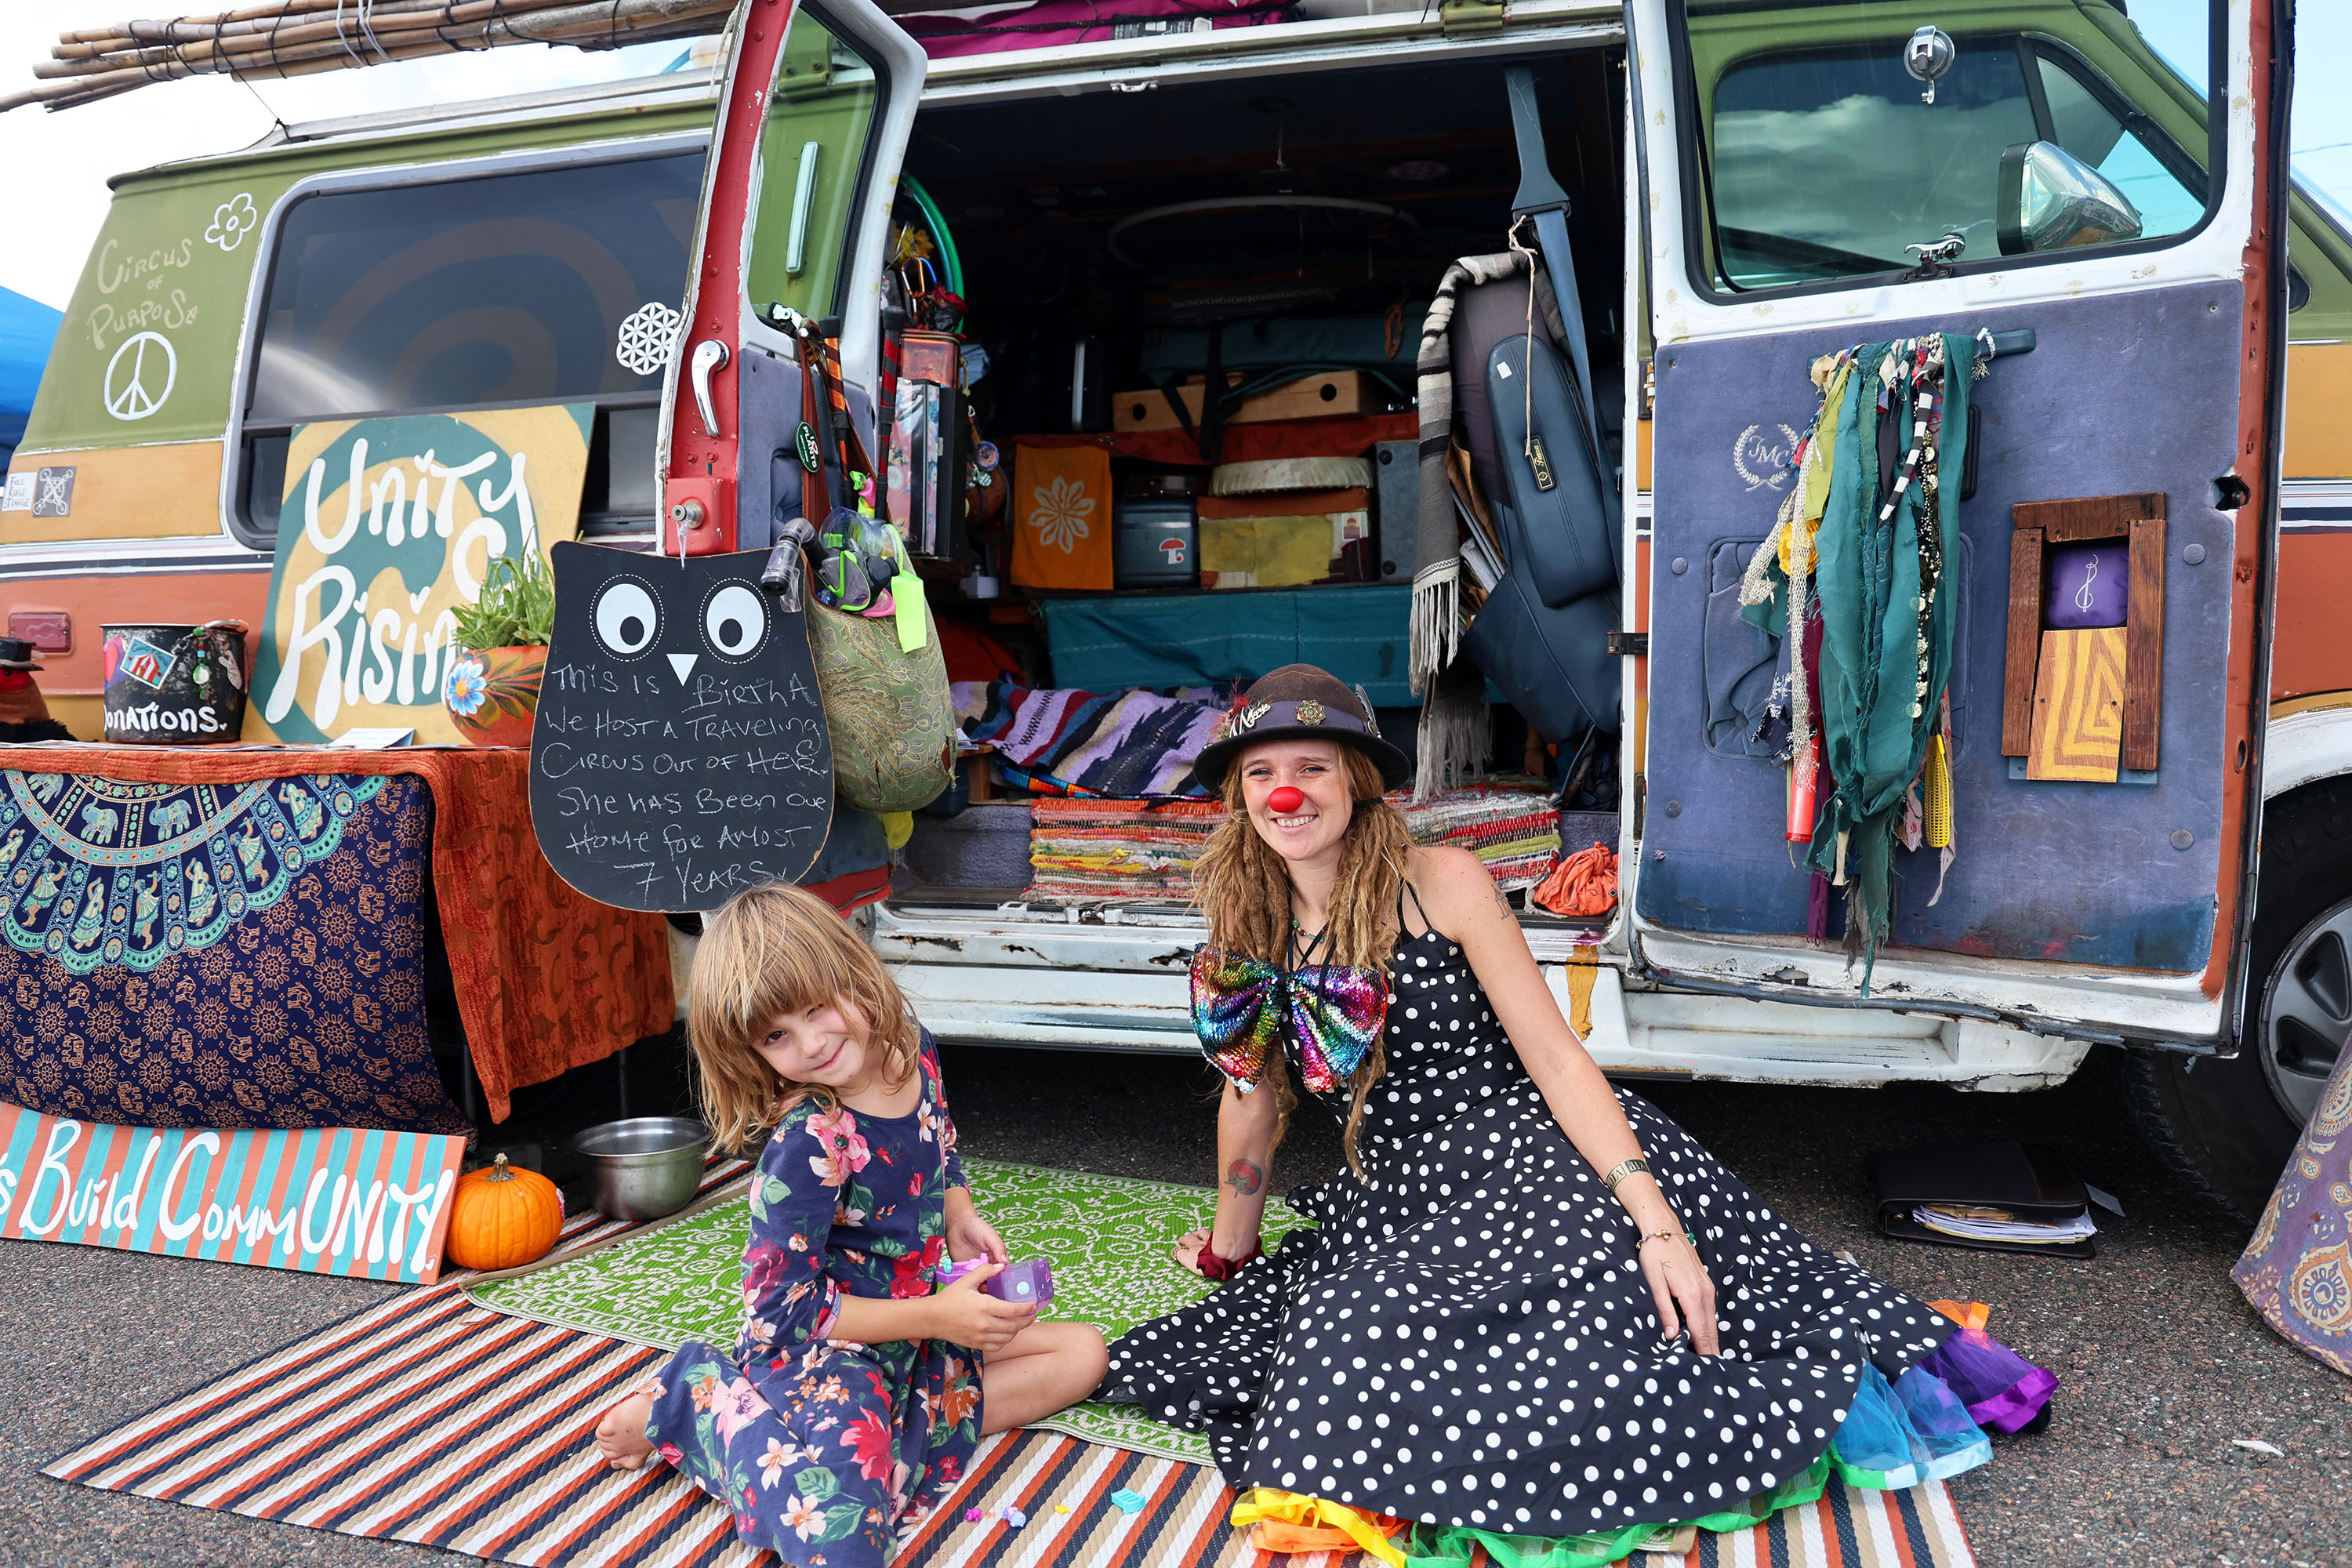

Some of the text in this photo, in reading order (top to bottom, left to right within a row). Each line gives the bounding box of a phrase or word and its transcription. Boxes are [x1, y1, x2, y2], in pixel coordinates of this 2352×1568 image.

[803, 426, 817, 468] PLANTS
[1534, 445, 1544, 466] Tiara
[265, 564, 468, 730] Risin
[663, 721, 678, 739] A
[613, 862, 665, 906] 7
[18, 1120, 162, 1235] Build
